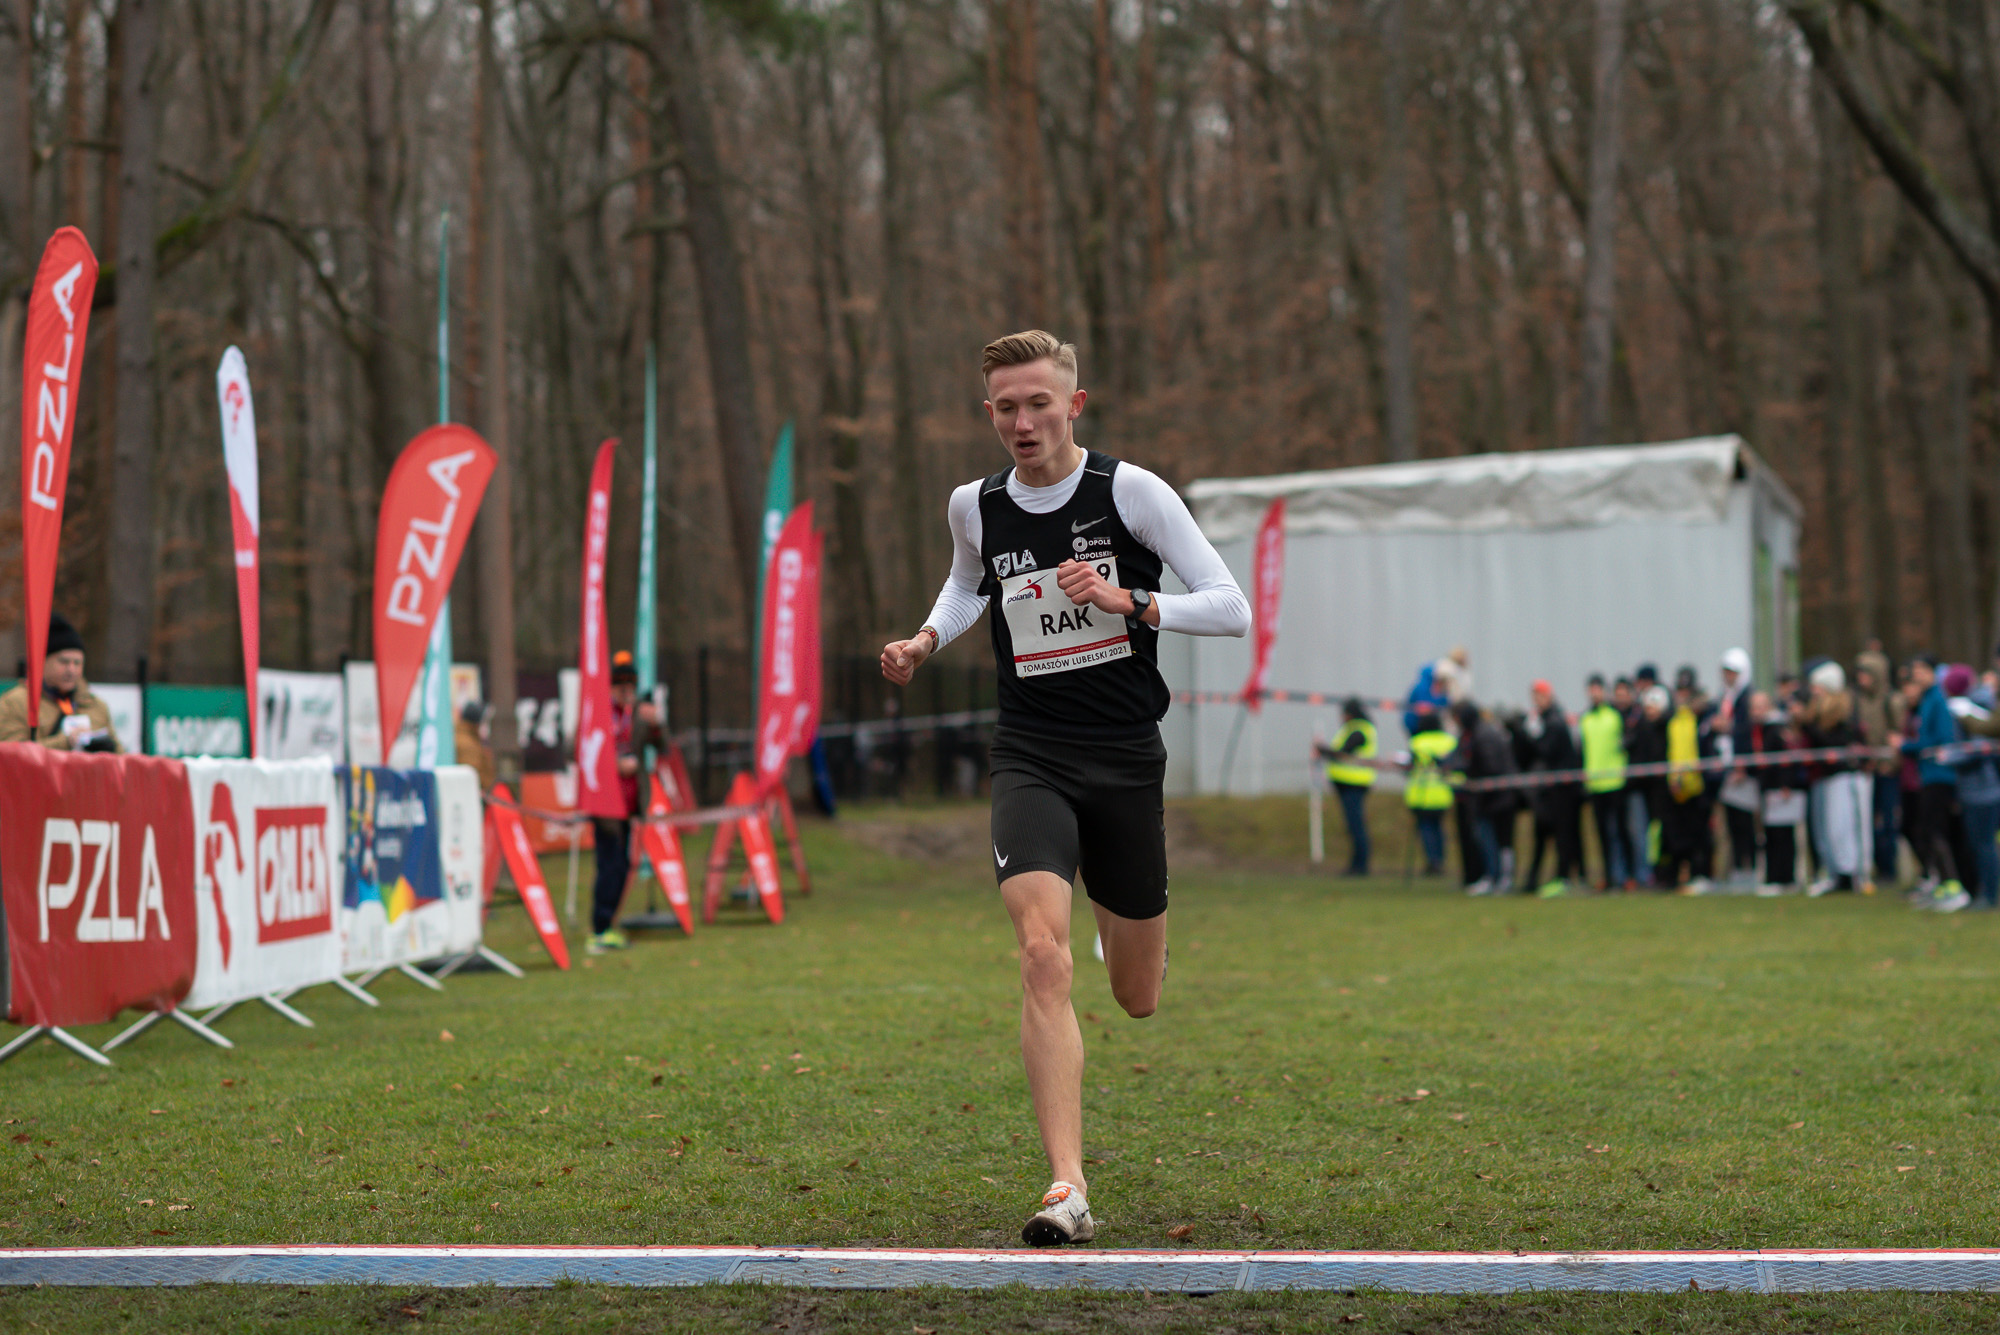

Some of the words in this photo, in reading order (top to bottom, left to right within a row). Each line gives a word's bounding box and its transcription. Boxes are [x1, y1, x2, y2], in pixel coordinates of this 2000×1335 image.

[31, 261, 83, 511] PZLA
[386, 449, 476, 627] PZLA
[1007, 591, 1034, 605] polanik
[1040, 606, 1094, 636] RAK
[1023, 659, 1070, 673] TOMASZÓW
[1072, 651, 1108, 665] LUBELSKI
[1109, 645, 1127, 657] 2021
[37, 817, 171, 943] PZLA
